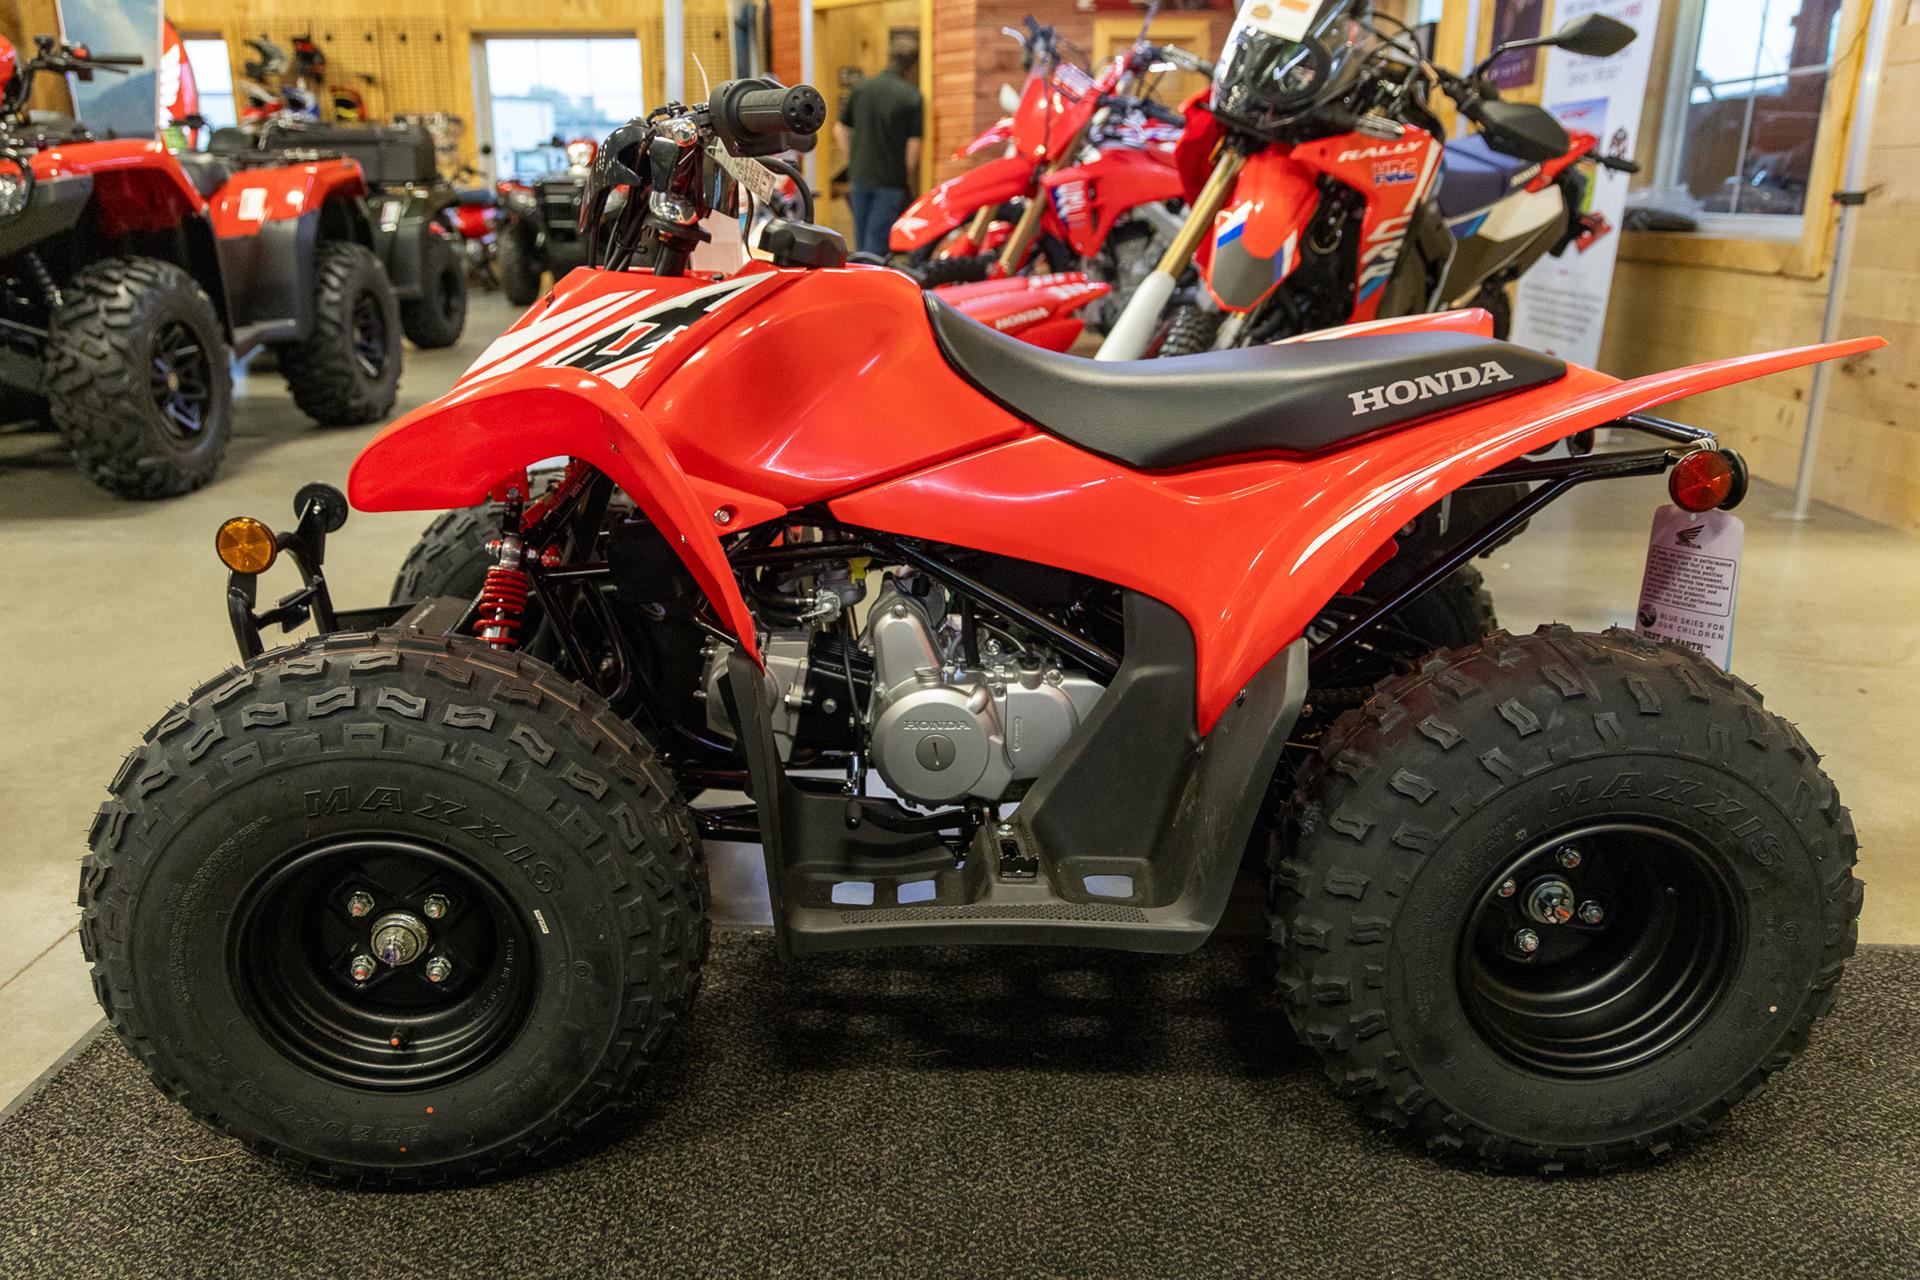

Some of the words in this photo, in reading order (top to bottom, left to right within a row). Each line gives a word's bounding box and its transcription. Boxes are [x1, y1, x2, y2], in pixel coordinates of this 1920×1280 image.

[1337, 140, 1424, 163] RALLY
[1373, 157, 1418, 188] HRC
[1348, 360, 1514, 416] HONDA
[1699, 557, 1732, 568] performance
[1658, 621, 1674, 630] OUR
[1676, 626, 1725, 641] CHILDREN
[1660, 612, 1678, 623] BLUE
[1680, 617, 1704, 629] SKIES
[1707, 622, 1726, 632] FOR
[903, 719, 972, 731] HONDA
[1546, 771, 1786, 867] MAXXIS
[303, 784, 563, 893] MAXXIS
